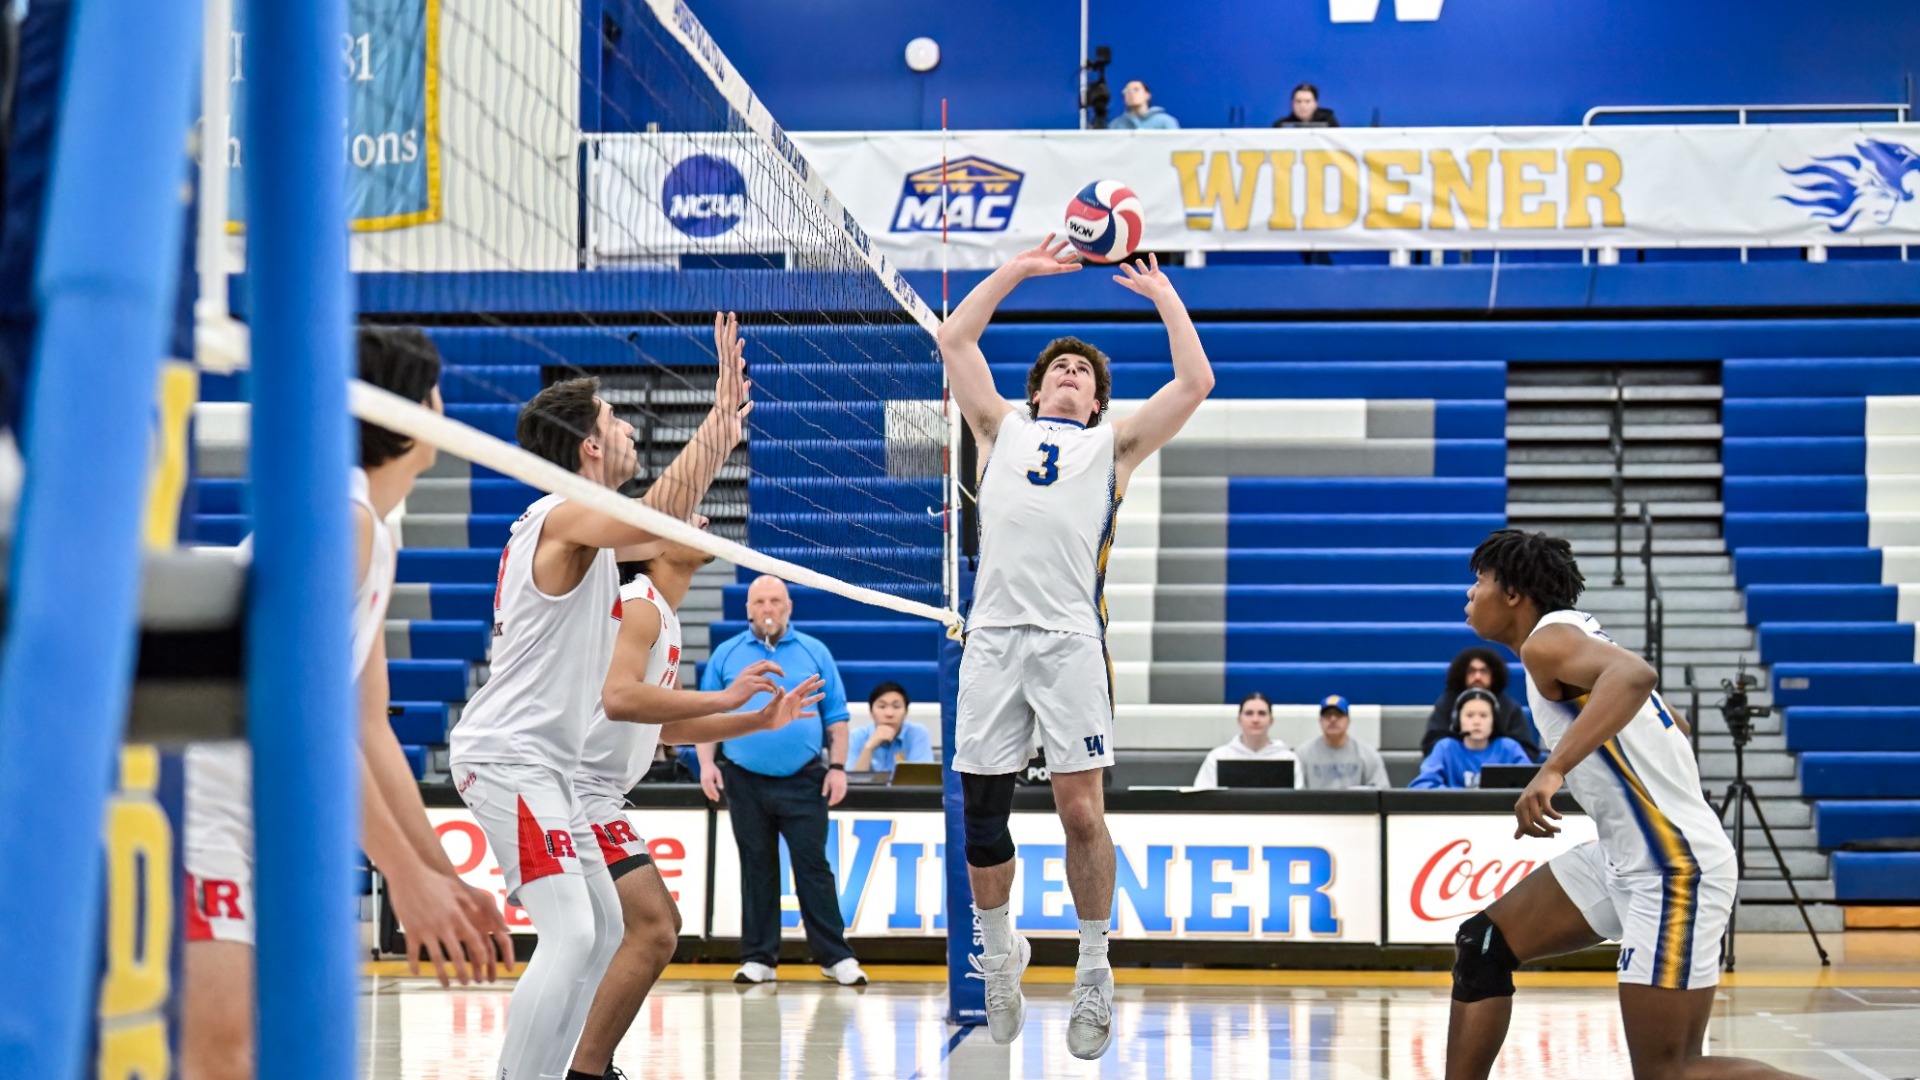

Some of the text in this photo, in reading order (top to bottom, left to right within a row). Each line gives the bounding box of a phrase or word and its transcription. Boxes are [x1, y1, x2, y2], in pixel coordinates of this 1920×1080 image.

[1171, 148, 1626, 231] WIDENER
[669, 193, 745, 219] NCAA
[896, 195, 1013, 229] MAC
[1026, 442, 1060, 486] 3
[1084, 734, 1105, 757] W
[547, 829, 577, 858] R
[603, 820, 639, 845] R
[202, 879, 245, 920] R
